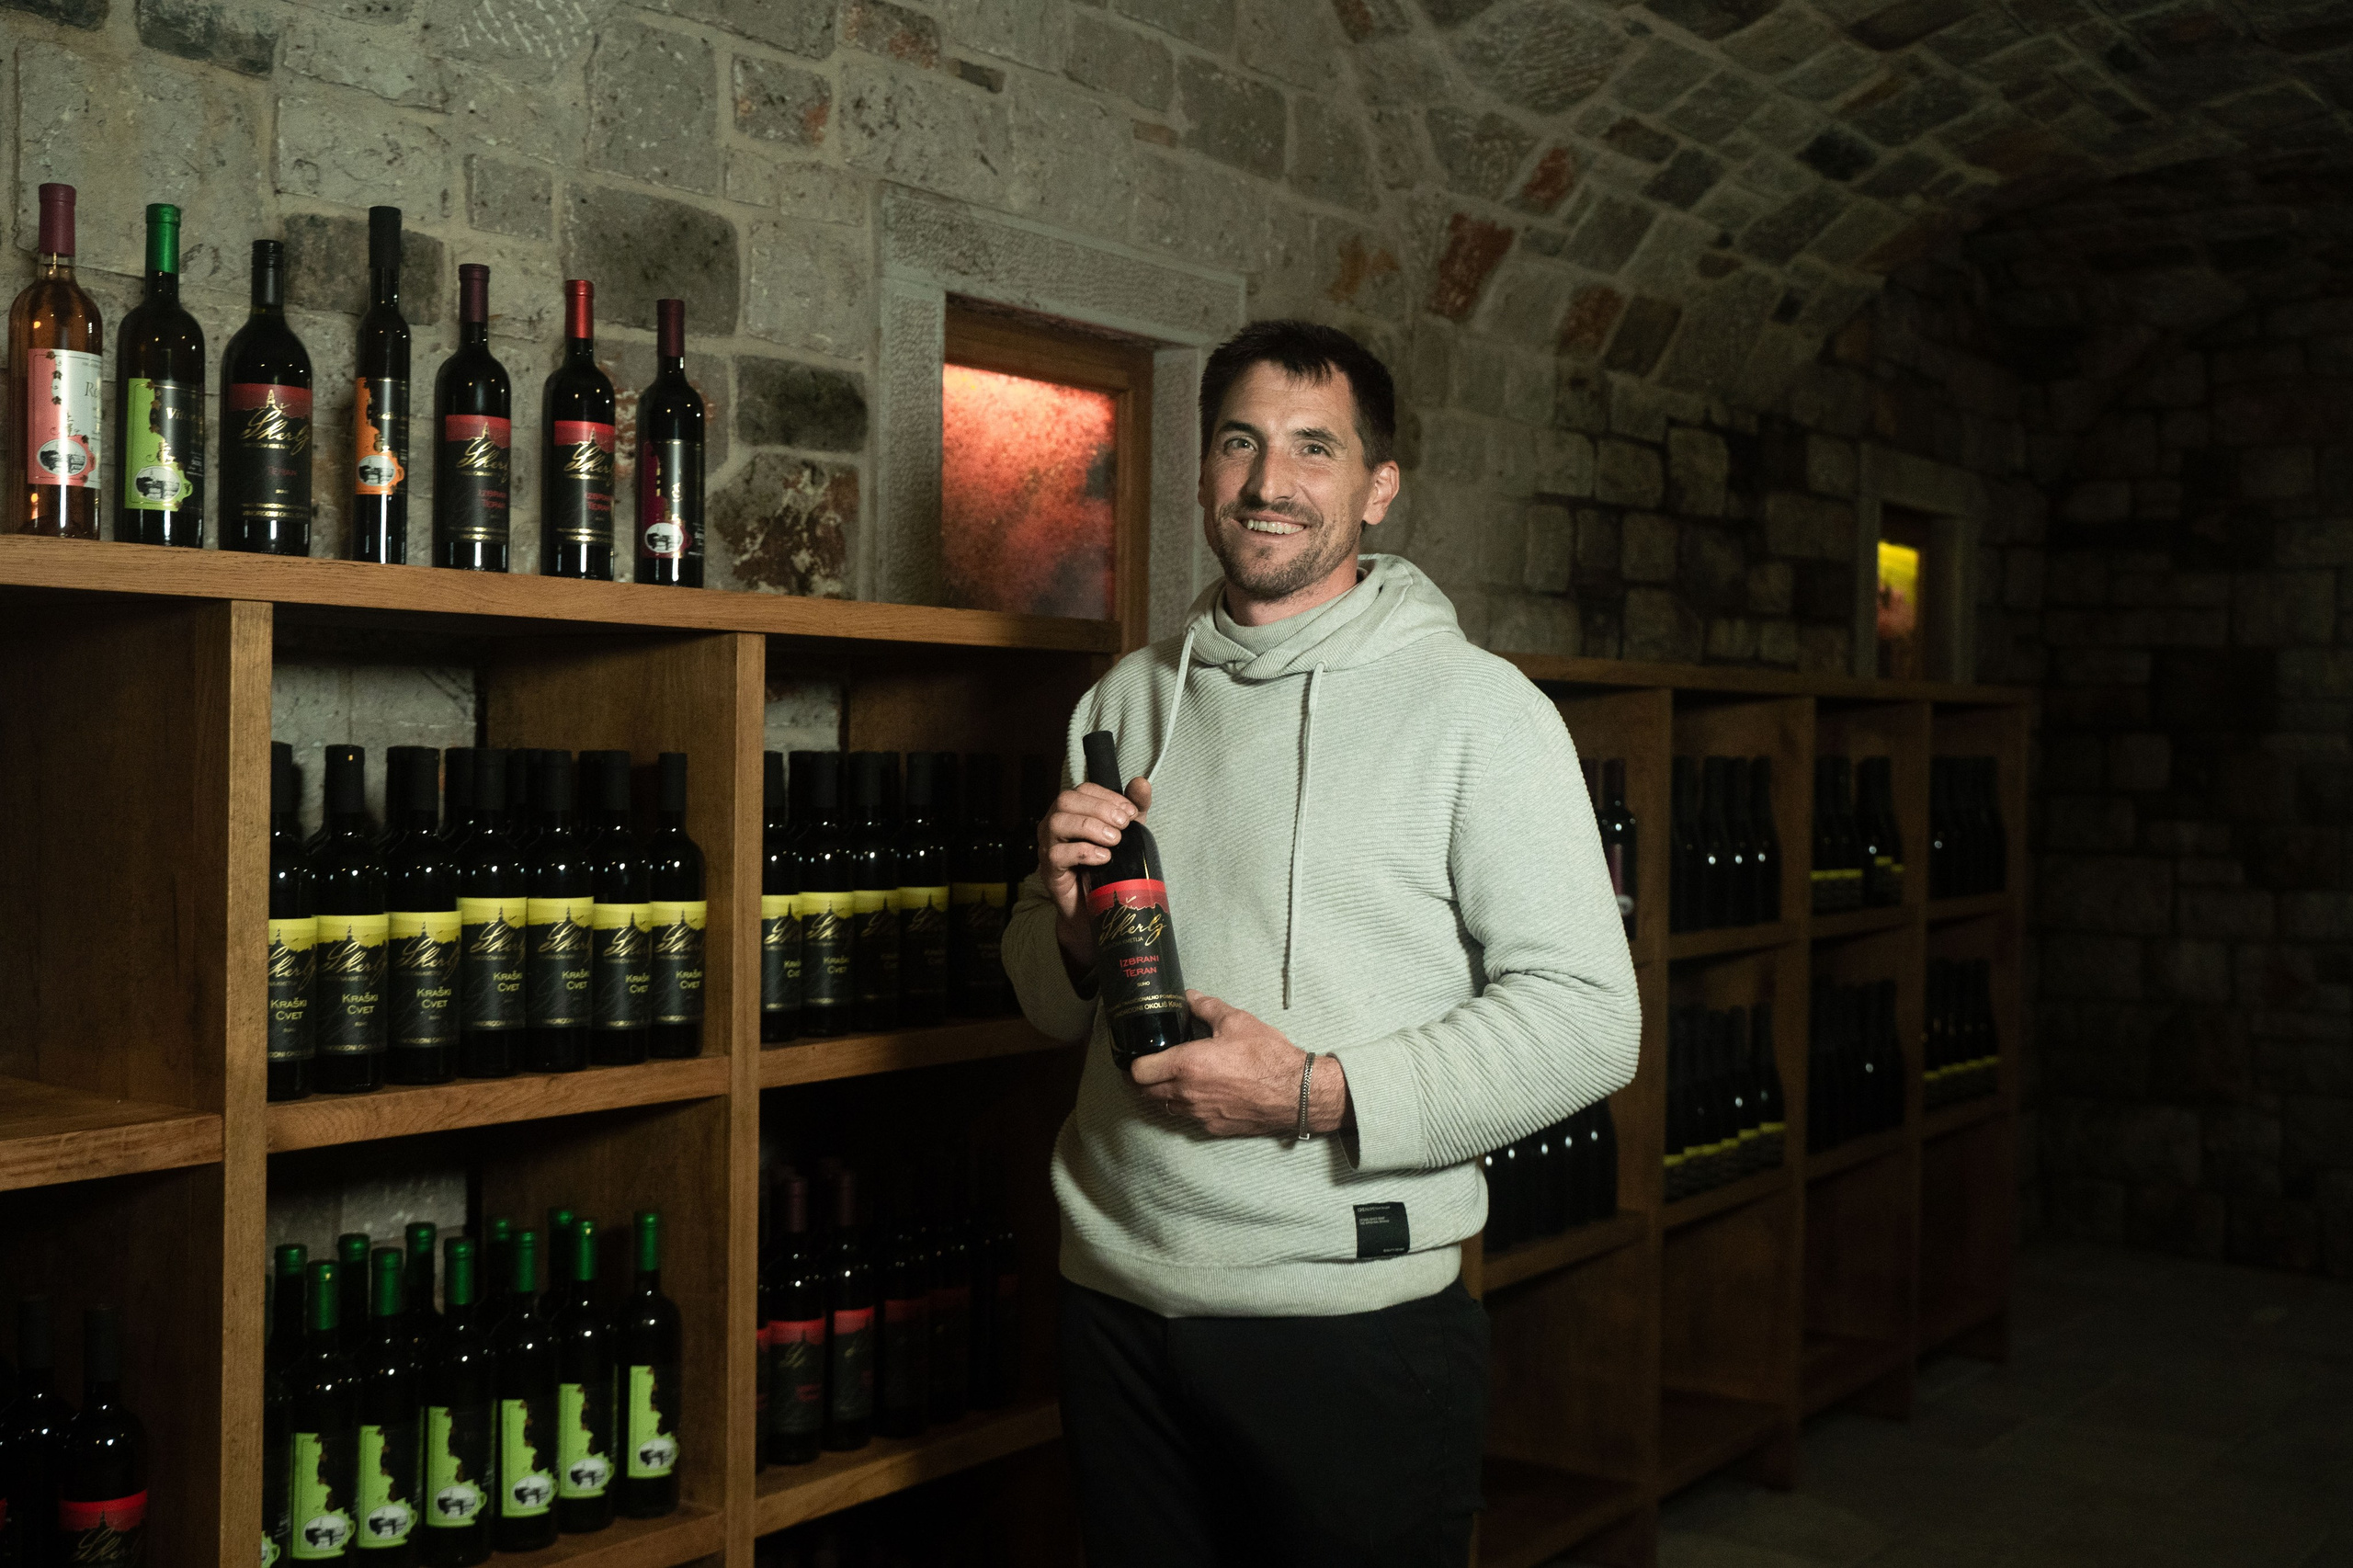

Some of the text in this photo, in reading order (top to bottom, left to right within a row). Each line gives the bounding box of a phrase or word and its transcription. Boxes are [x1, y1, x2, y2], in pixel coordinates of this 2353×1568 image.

[1120, 955, 1160, 968] IZBRANI
[1123, 966, 1157, 979] TERAN
[496, 982, 521, 993] CVET
[566, 980, 588, 991] CVET
[679, 980, 700, 990] CVET
[415, 984, 453, 998] KRAŠKI
[269, 996, 308, 1009] KRAŠKI
[341, 991, 379, 1004] KRAŠKI
[421, 998, 449, 1009] CVET
[1143, 1000, 1168, 1010] OKOLIŠ
[275, 1010, 304, 1021] CVET
[346, 1004, 375, 1016] CVET
